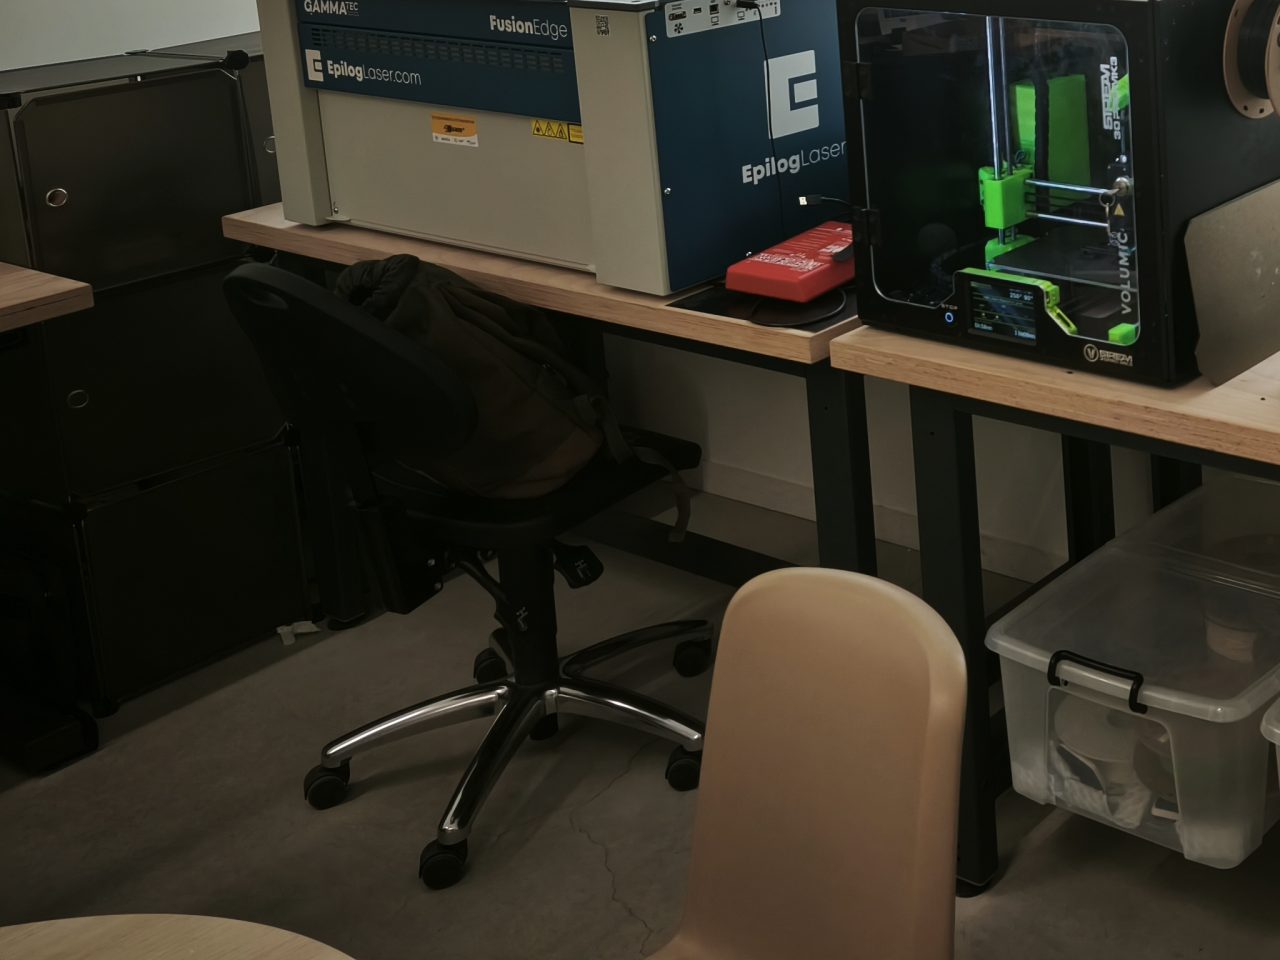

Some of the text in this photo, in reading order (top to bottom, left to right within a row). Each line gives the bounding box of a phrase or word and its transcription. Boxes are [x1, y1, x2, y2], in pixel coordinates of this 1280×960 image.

[489, 14, 568, 40] FusionEdge
[327, 60, 422, 86] EpilogLaser.com
[1100, 63, 1113, 130] STREAM
[741, 141, 847, 185] EpilogLaser
[1117, 231, 1132, 315] VOLUMIC
